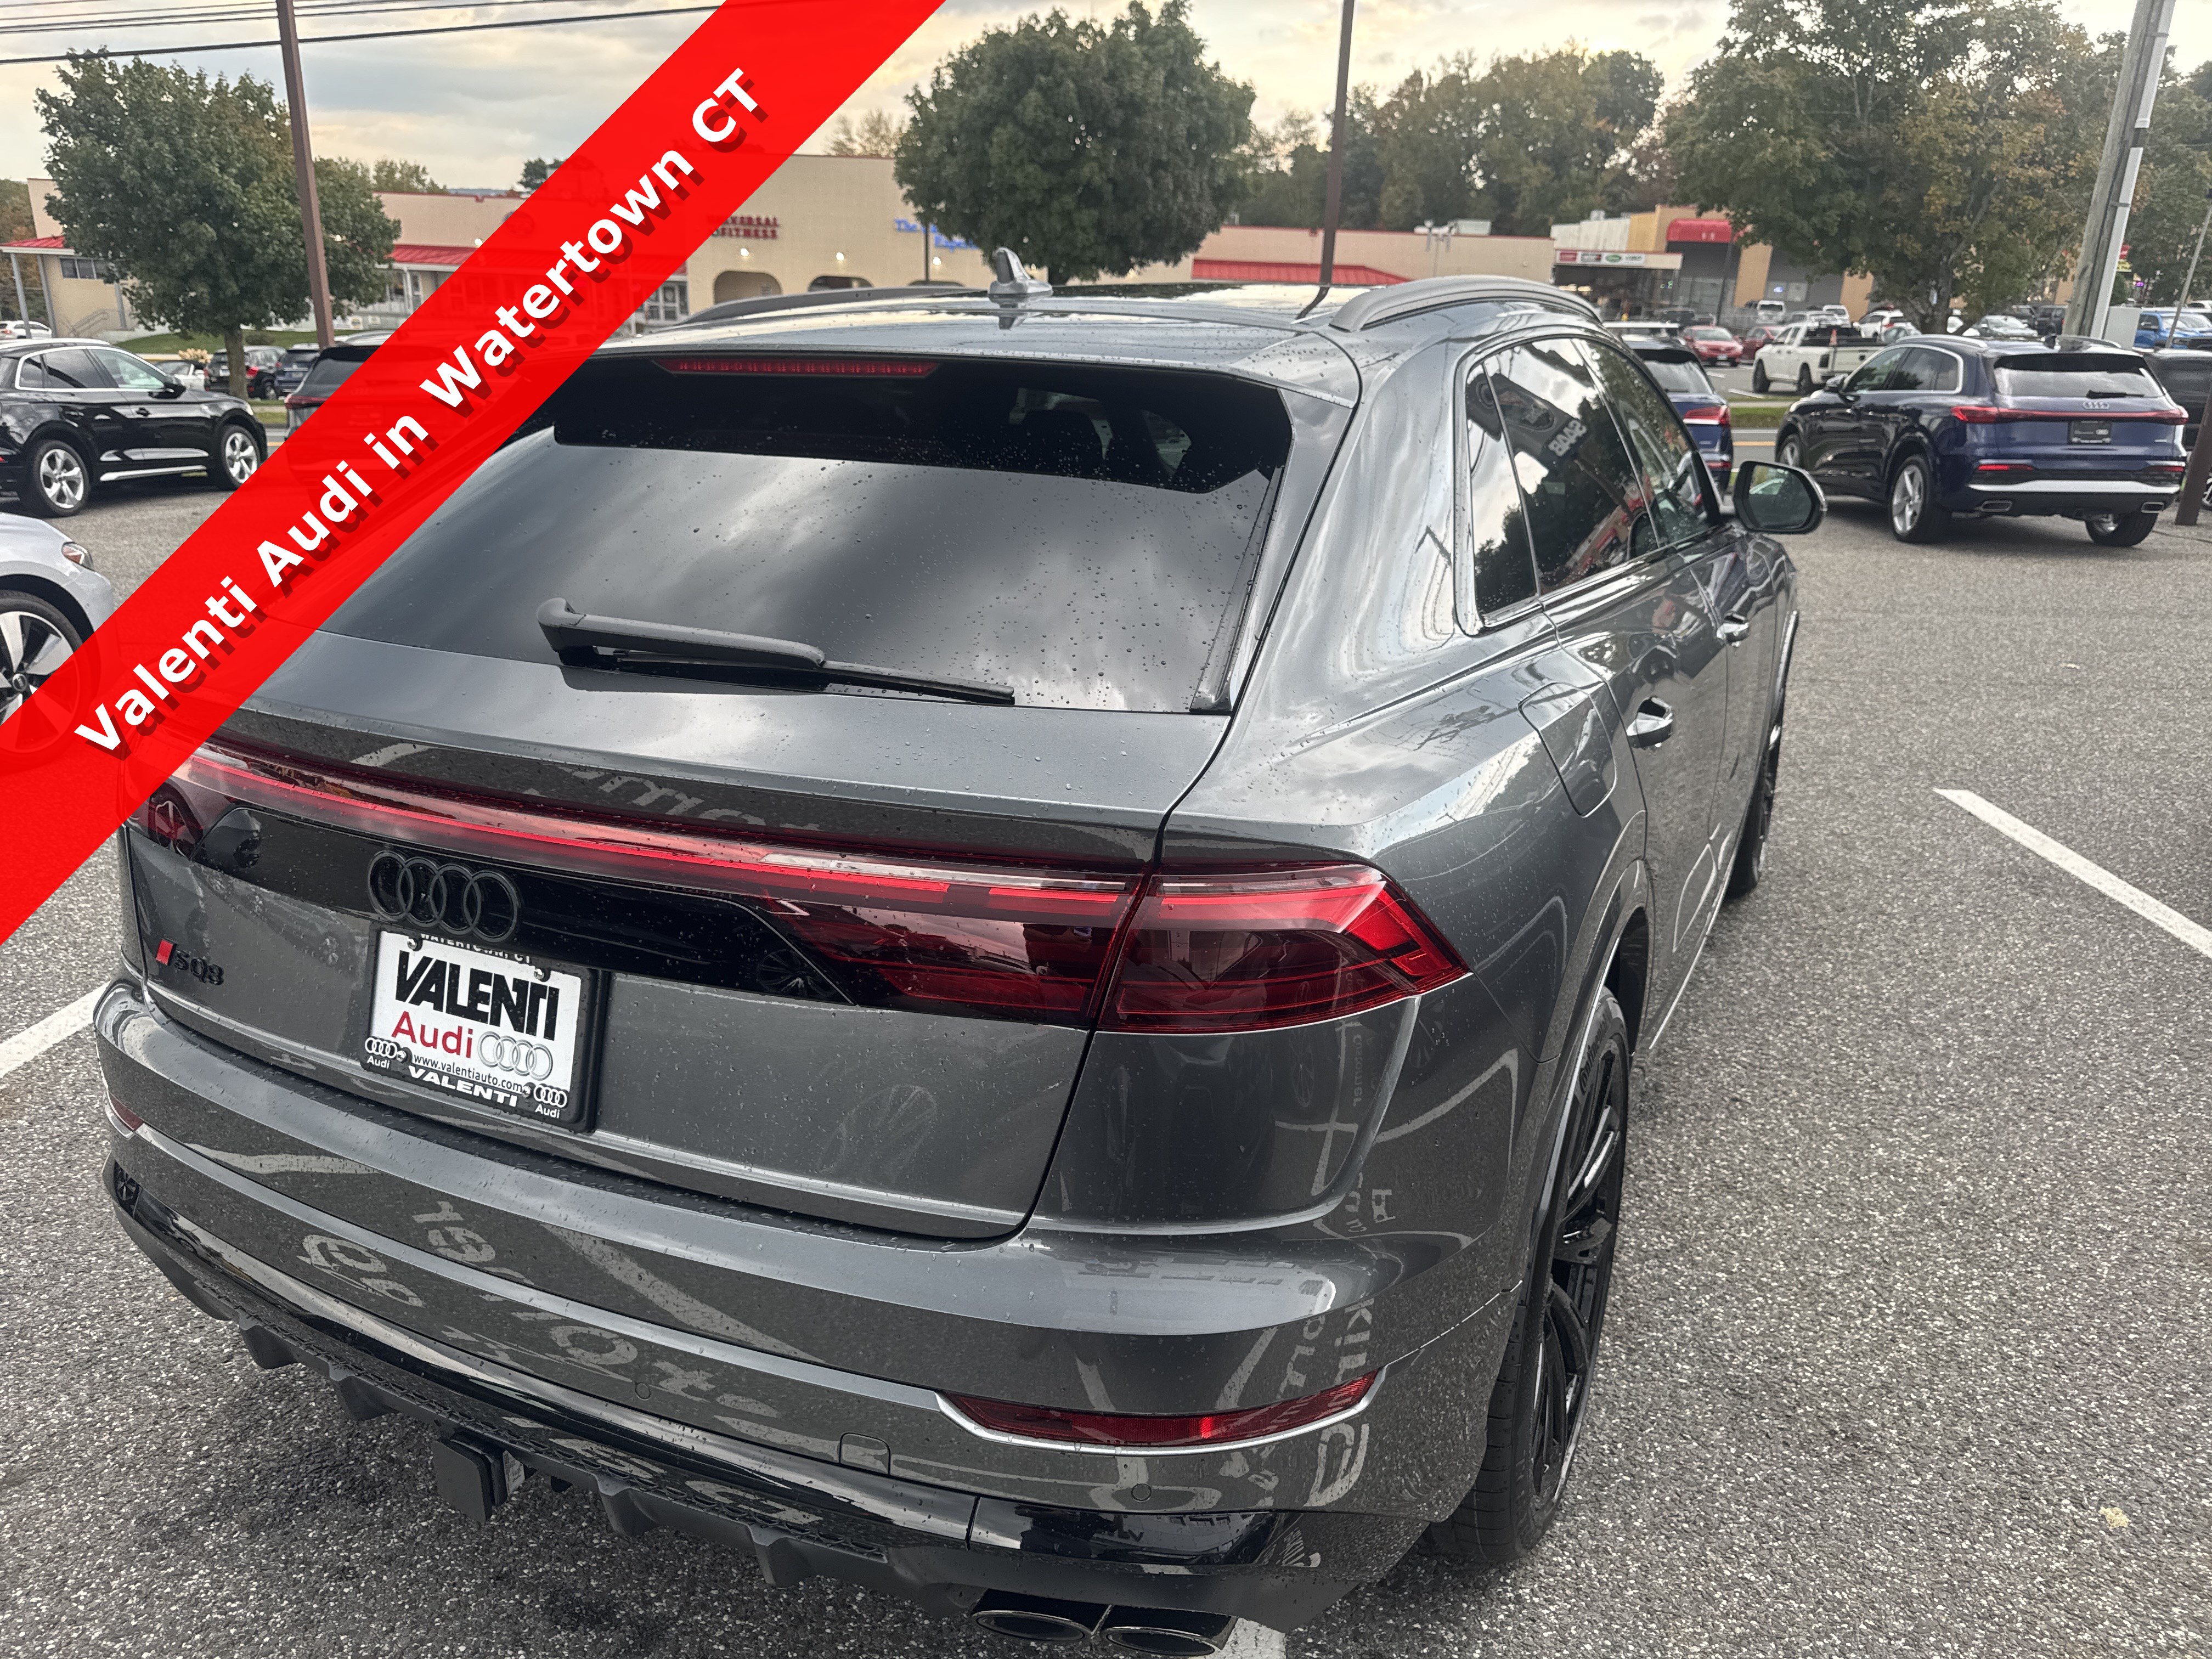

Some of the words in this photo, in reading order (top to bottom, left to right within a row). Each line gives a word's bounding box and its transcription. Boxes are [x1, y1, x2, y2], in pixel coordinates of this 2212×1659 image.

[174, 950, 224, 985] SQ8
[396, 950, 560, 1041] VALENTI
[391, 1011, 473, 1058] Audi
[367, 1054, 390, 1069] Audi
[414, 1054, 522, 1092] www.valentiauto.com
[408, 1065, 518, 1107] VALENTI
[535, 1104, 560, 1119] Audi
